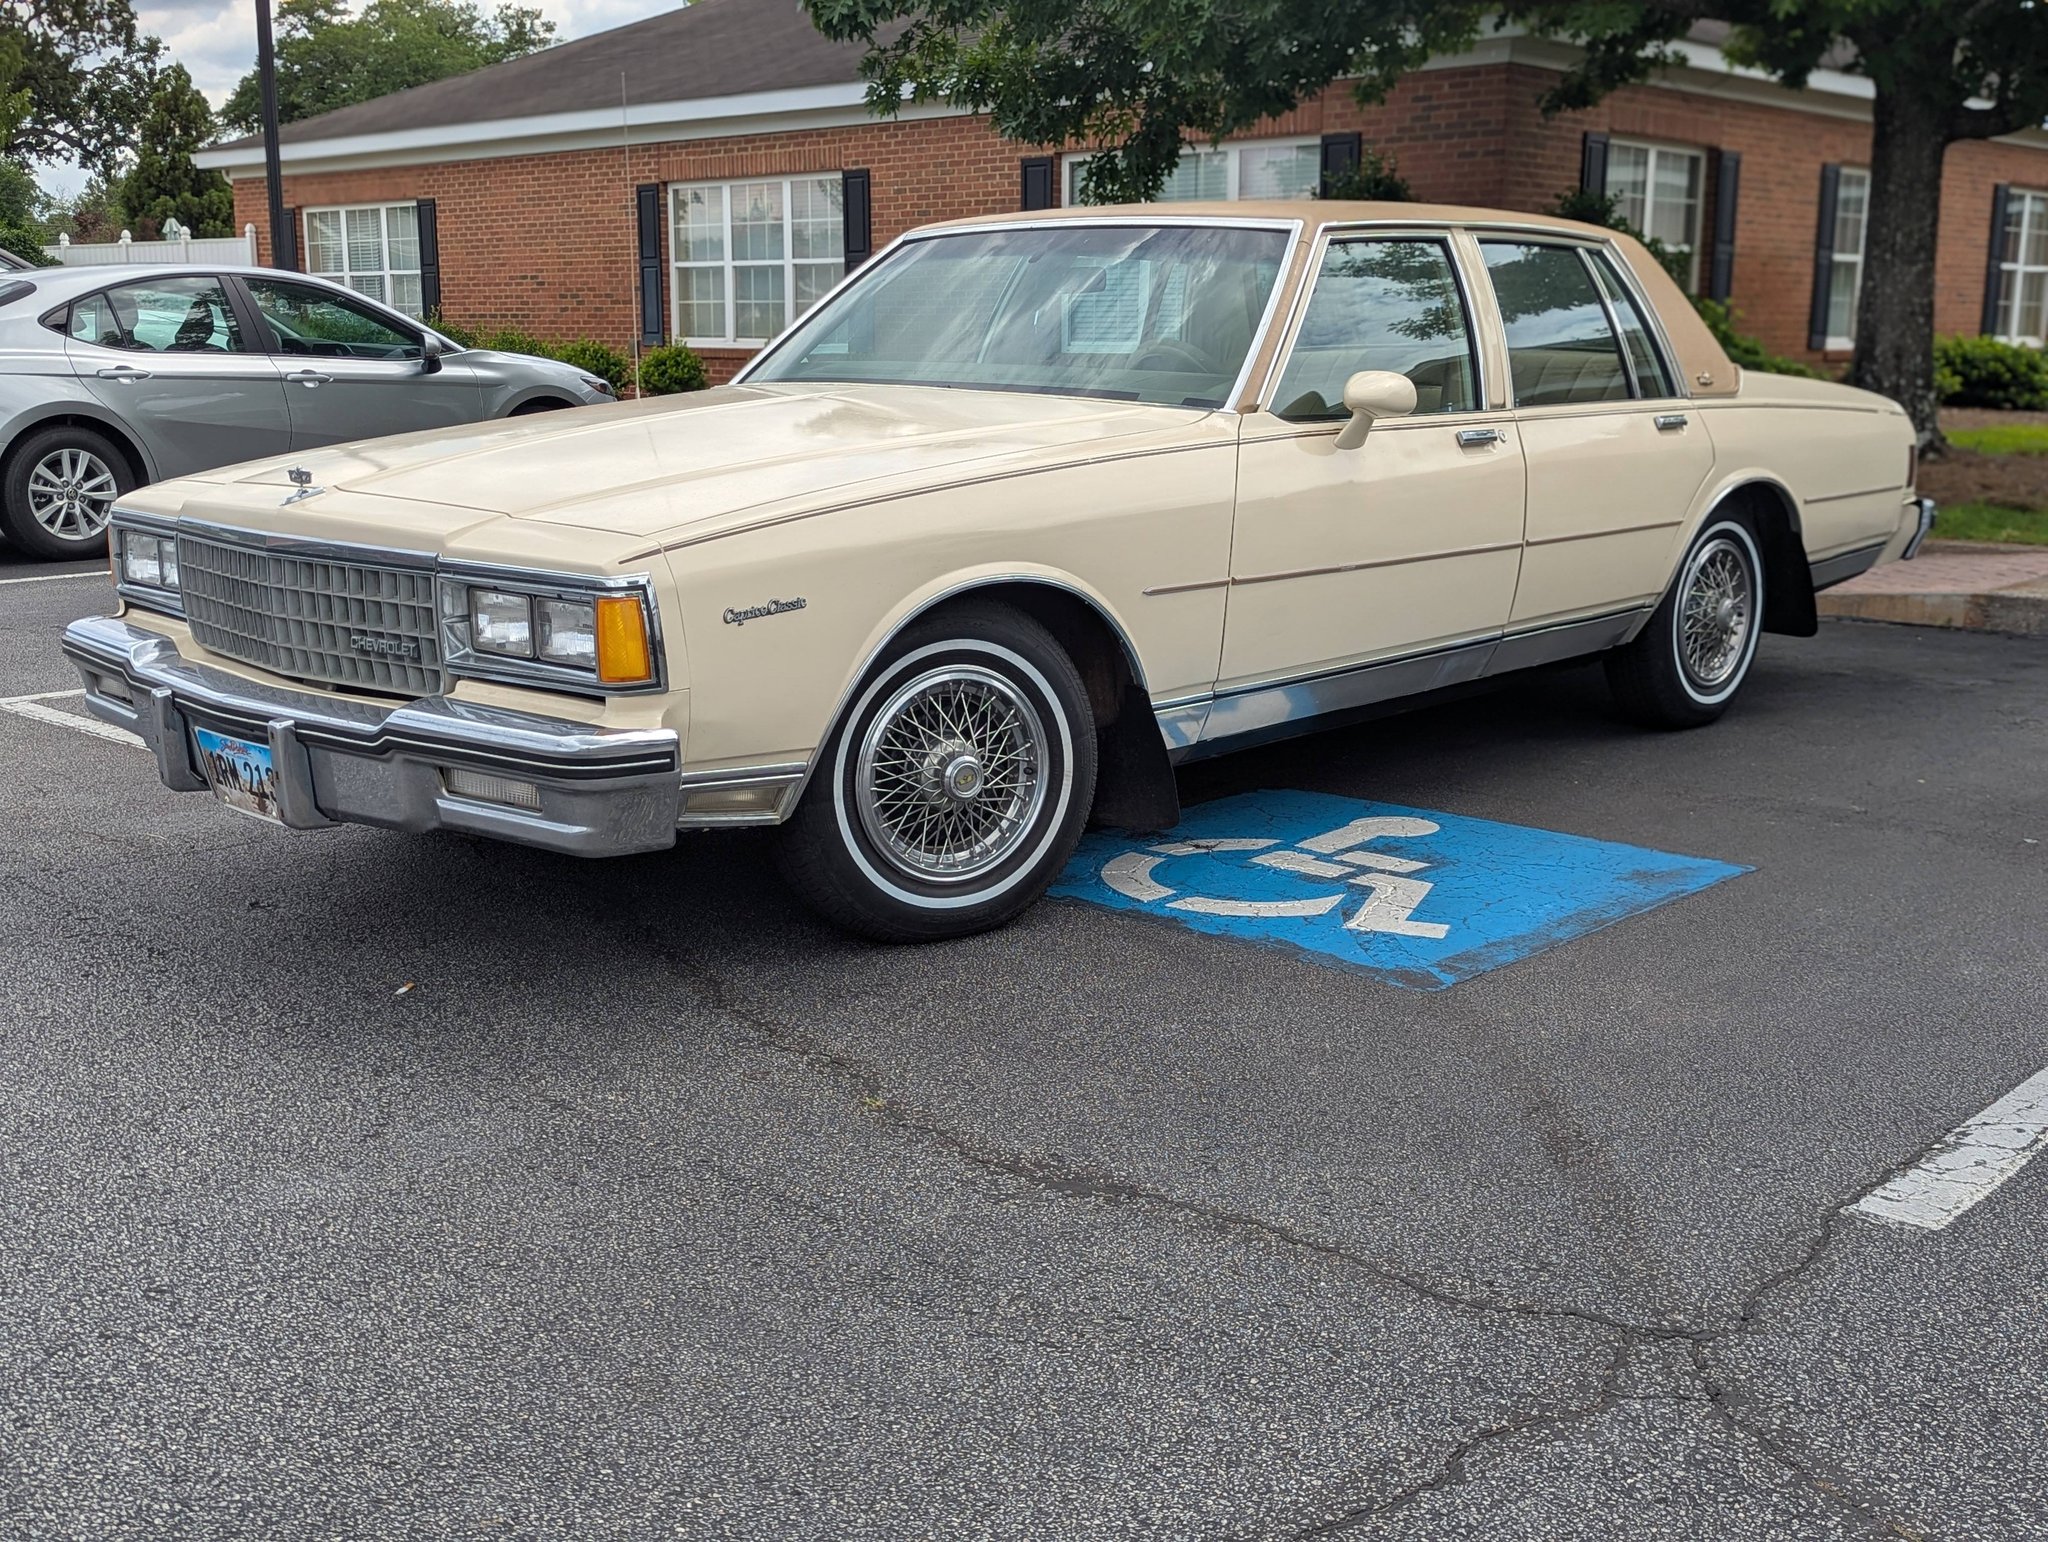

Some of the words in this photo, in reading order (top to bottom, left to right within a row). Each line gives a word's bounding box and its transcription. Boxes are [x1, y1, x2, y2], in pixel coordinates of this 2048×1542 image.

[723, 606, 768, 626] Caprice
[767, 597, 807, 615] Classic
[351, 636, 417, 657] CHEVROLET
[209, 751, 244, 793] 1RM
